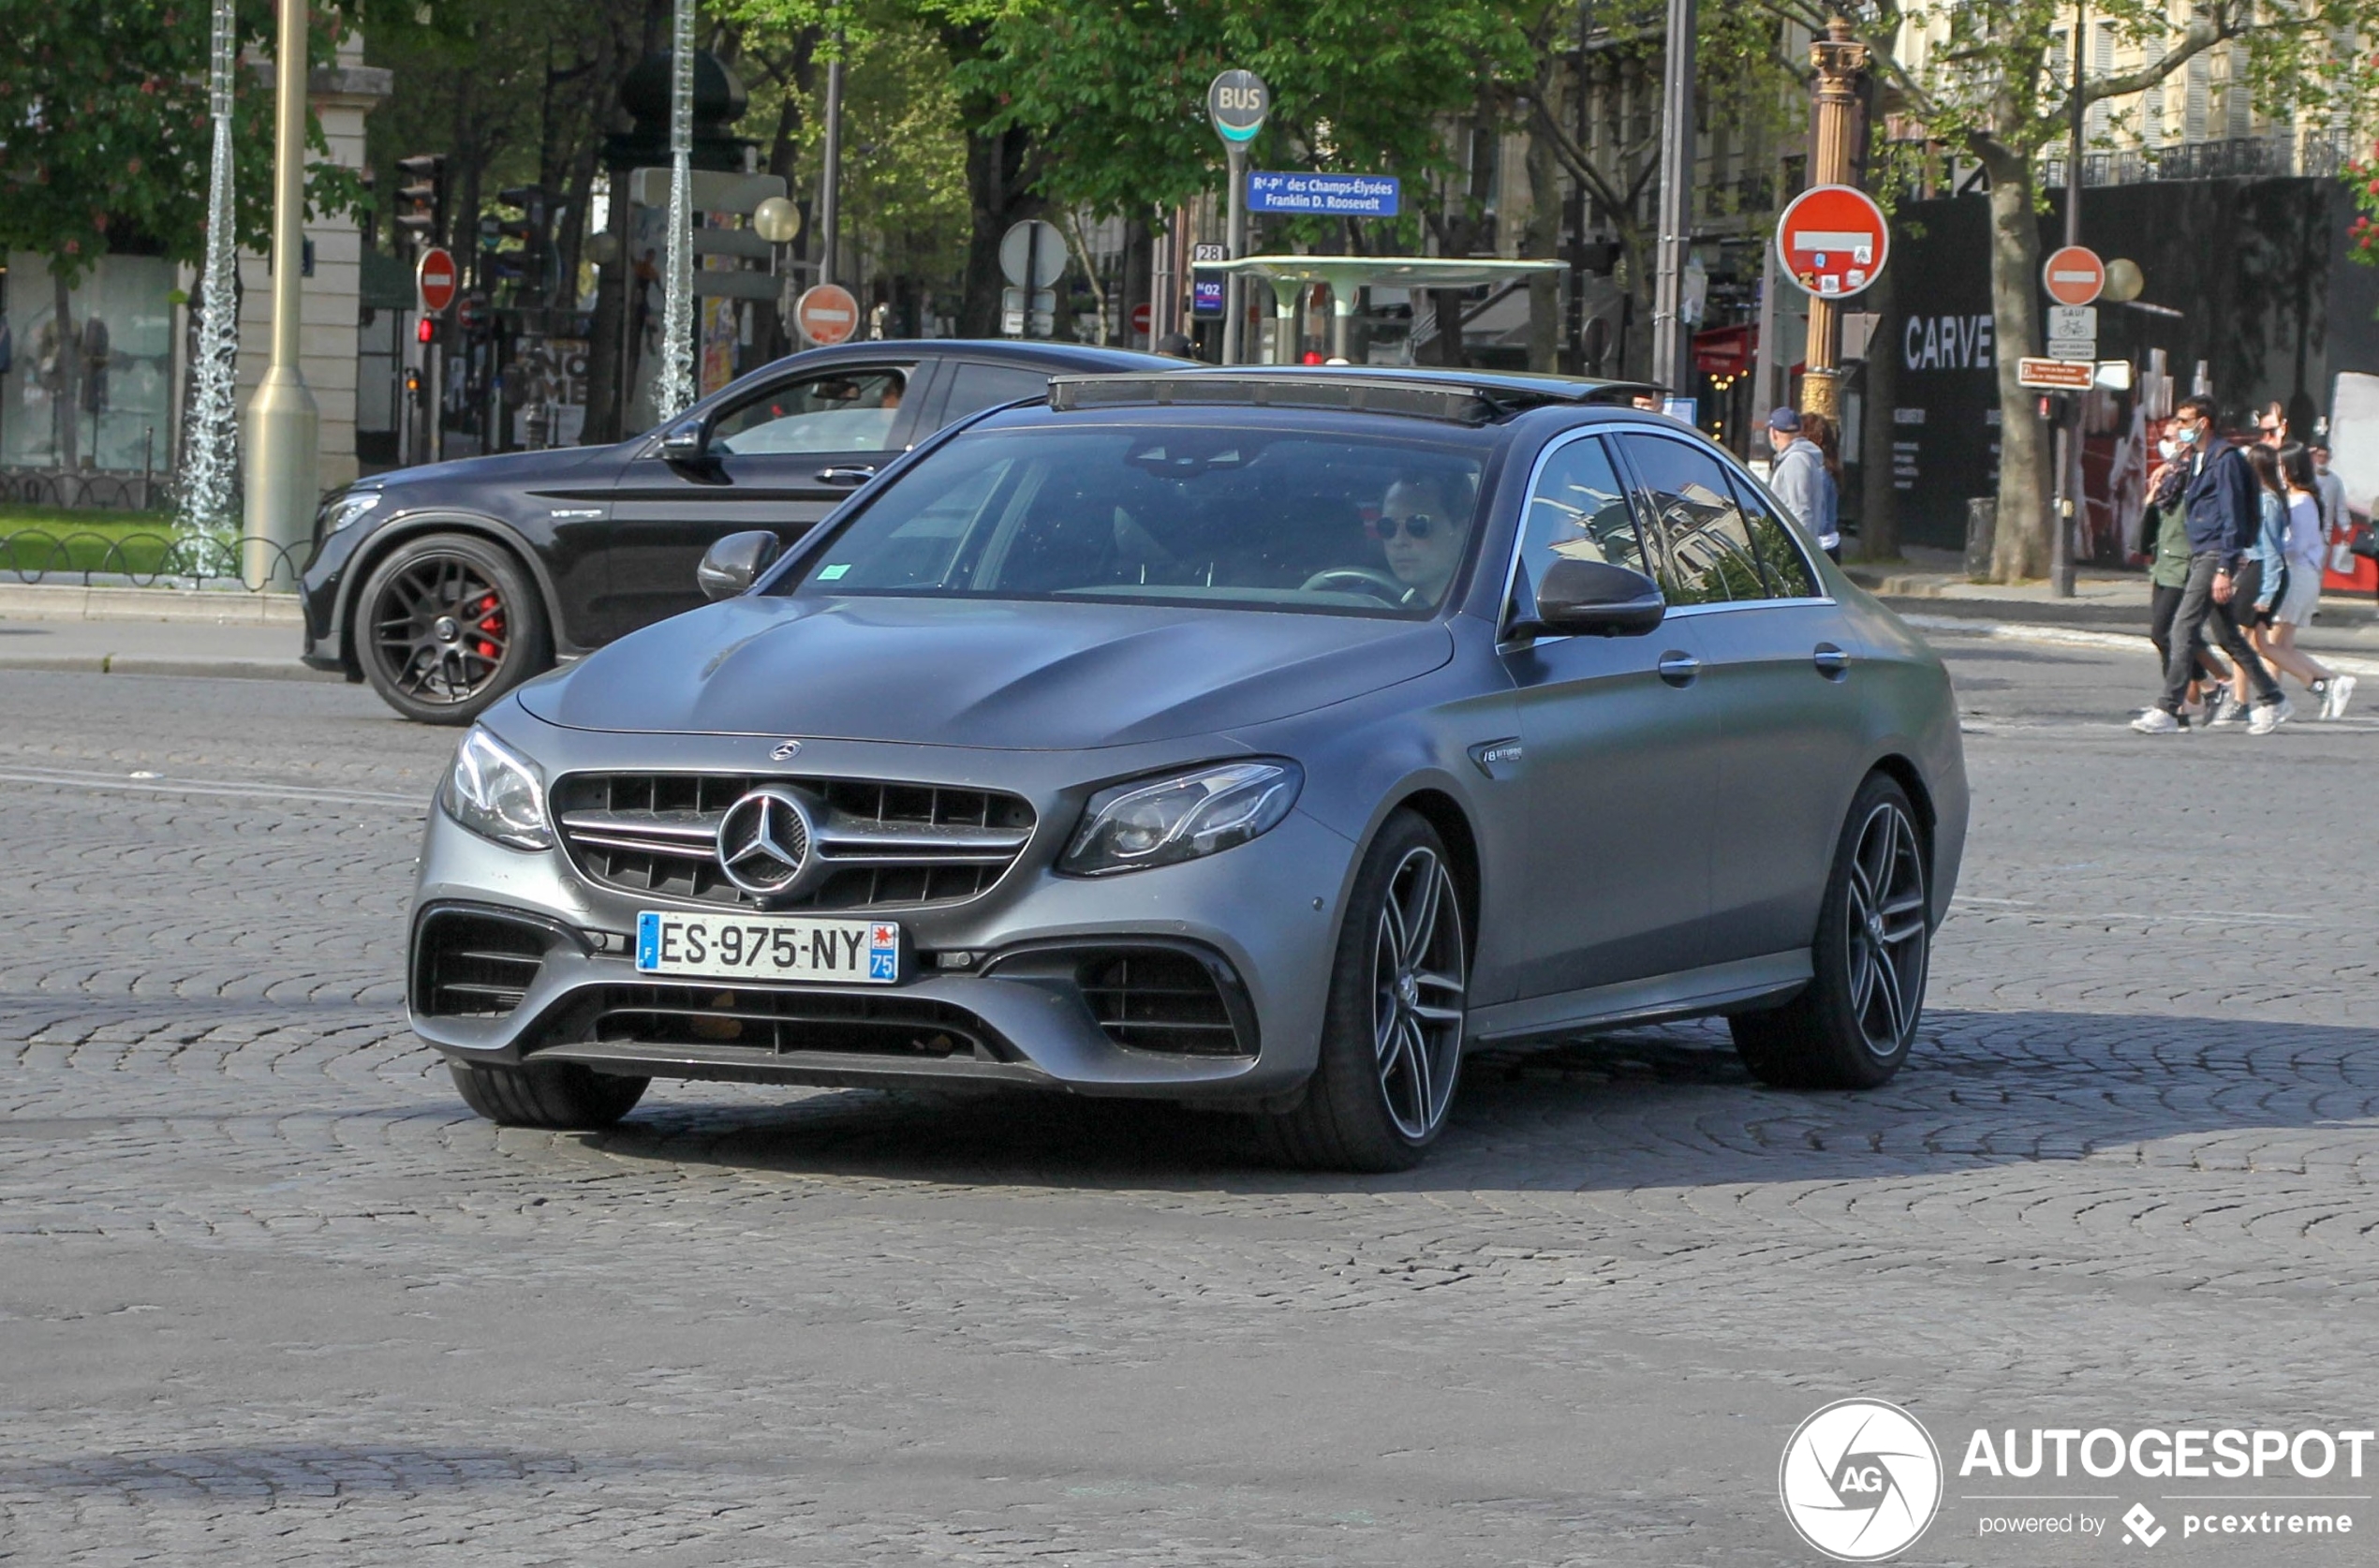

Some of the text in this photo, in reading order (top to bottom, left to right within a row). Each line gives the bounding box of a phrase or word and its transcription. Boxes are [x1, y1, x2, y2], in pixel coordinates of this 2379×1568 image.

[1219, 86, 1261, 110] BUS
[1287, 178, 1307, 192] des
[1308, 178, 1393, 197] Champs-Élysées
[1265, 194, 1381, 211] Franklin D. Roosevelt
[1200, 246, 1219, 260] 28
[2061, 308, 2087, 318] SAUF
[1906, 315, 1999, 370] CARVE
[643, 922, 894, 975] F ES-975-NY 75
